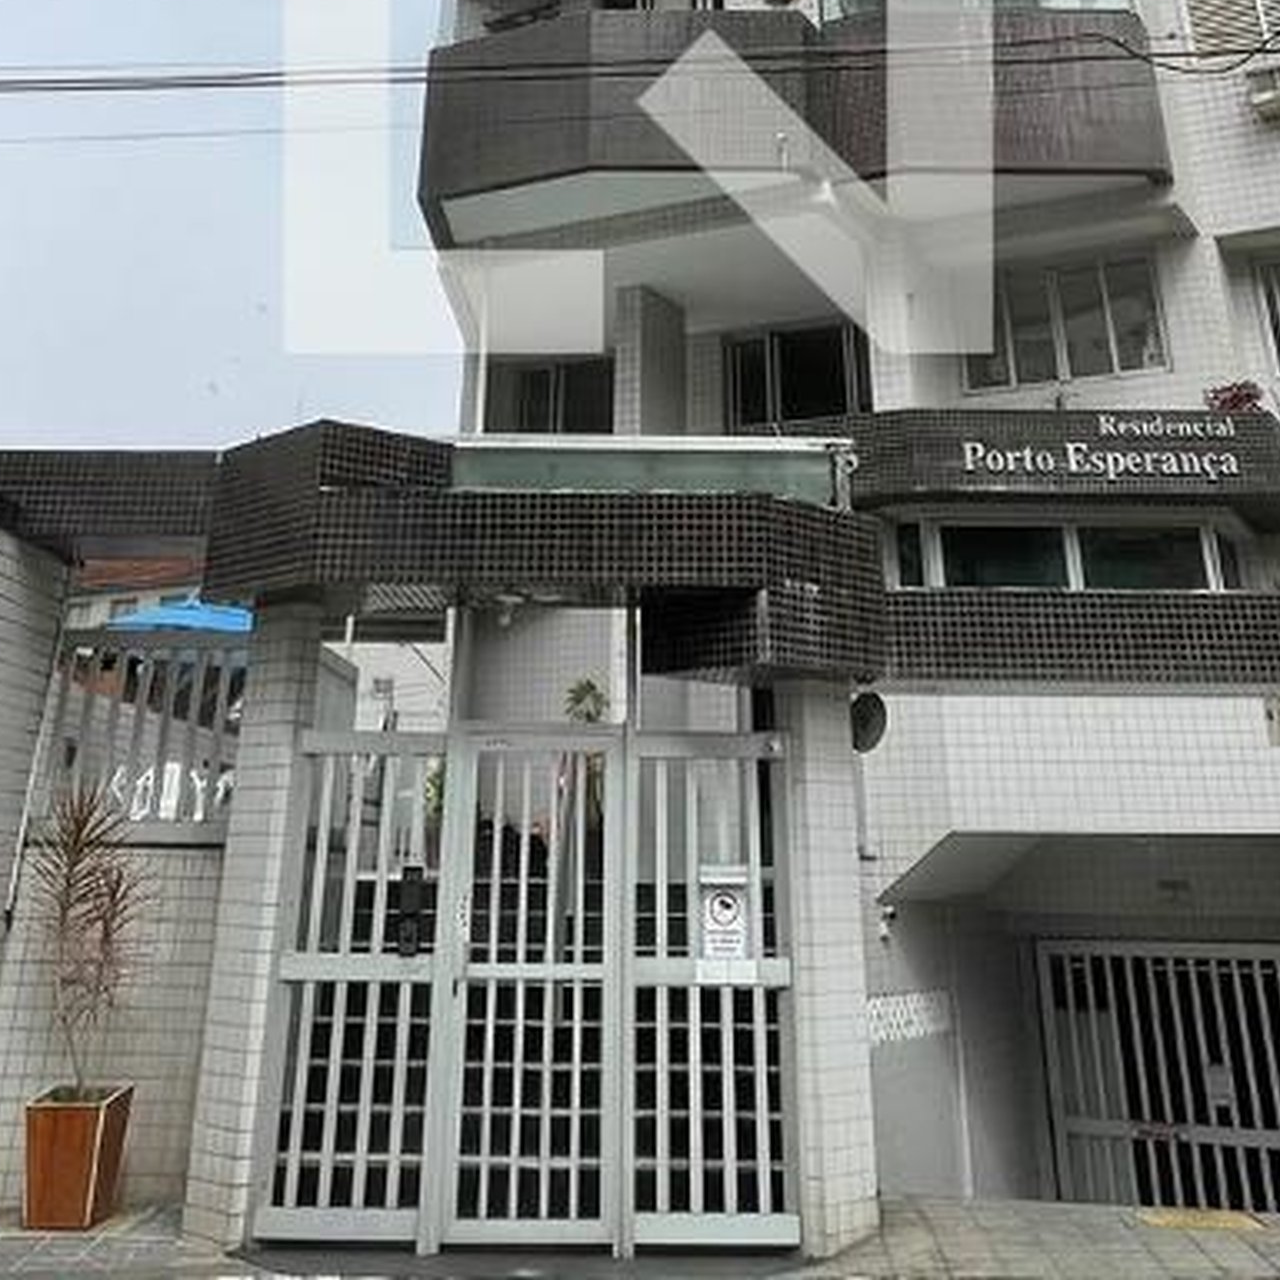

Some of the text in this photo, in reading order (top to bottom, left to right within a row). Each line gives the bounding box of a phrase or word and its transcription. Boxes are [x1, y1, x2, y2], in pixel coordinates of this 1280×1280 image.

[1097, 414, 1236, 437] Residencial
[962, 441, 1240, 480] Porto Esperança
